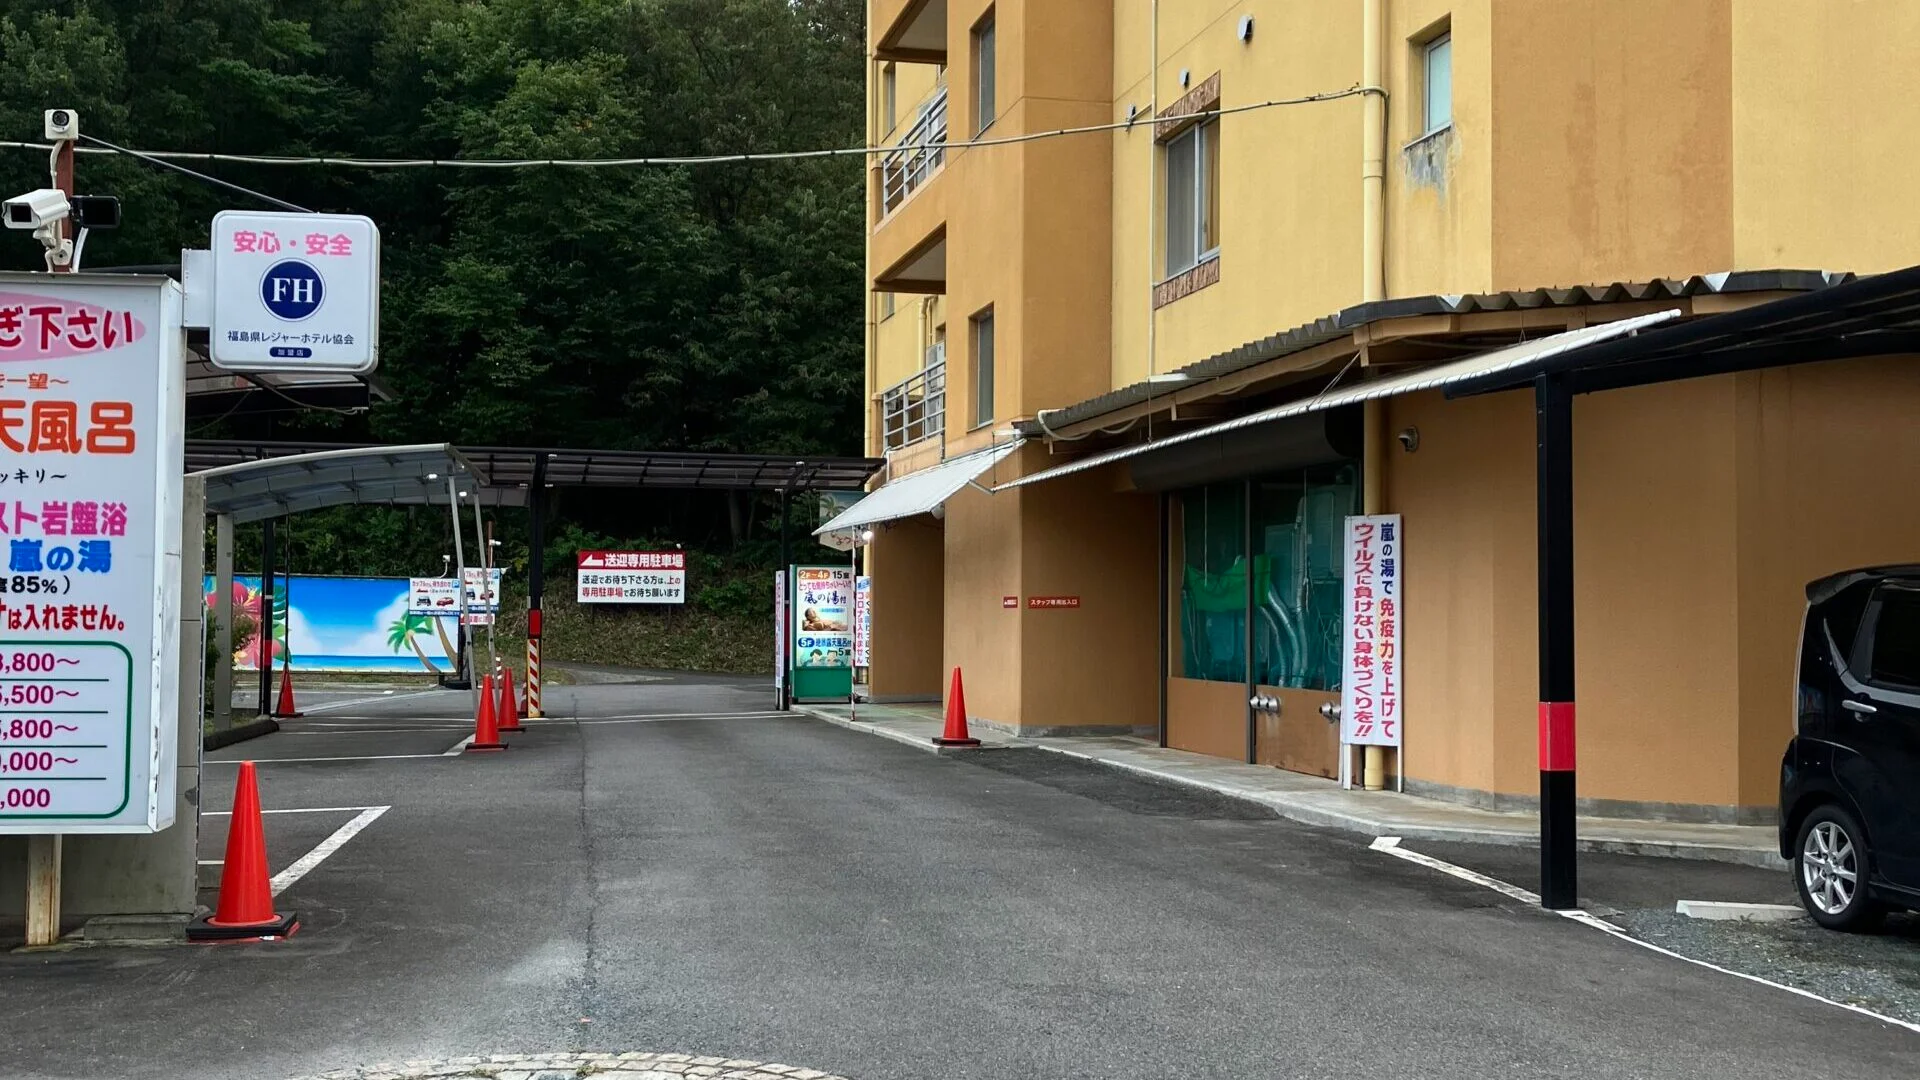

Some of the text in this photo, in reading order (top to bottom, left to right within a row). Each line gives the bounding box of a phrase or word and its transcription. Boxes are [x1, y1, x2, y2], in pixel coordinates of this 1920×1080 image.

[233, 231, 353, 256] 安心・安全
[271, 277, 316, 303] FH
[0, 305, 133, 350] ぎ下さい
[228, 331, 354, 345] 福島県レジャーホテル協会
[9, 538, 112, 573] 嵐の湯
[605, 553, 683, 568] 送迎専用駐車場
[582, 587, 680, 598] 専用駐車場でお待ち願います
[1380, 523, 1395, 738] 嵐の湯で免疫力を上げて
[0, 652, 81, 674] ,800〜
[0, 685, 80, 706] ,500〜
[0, 719, 79, 740] ,800〜
